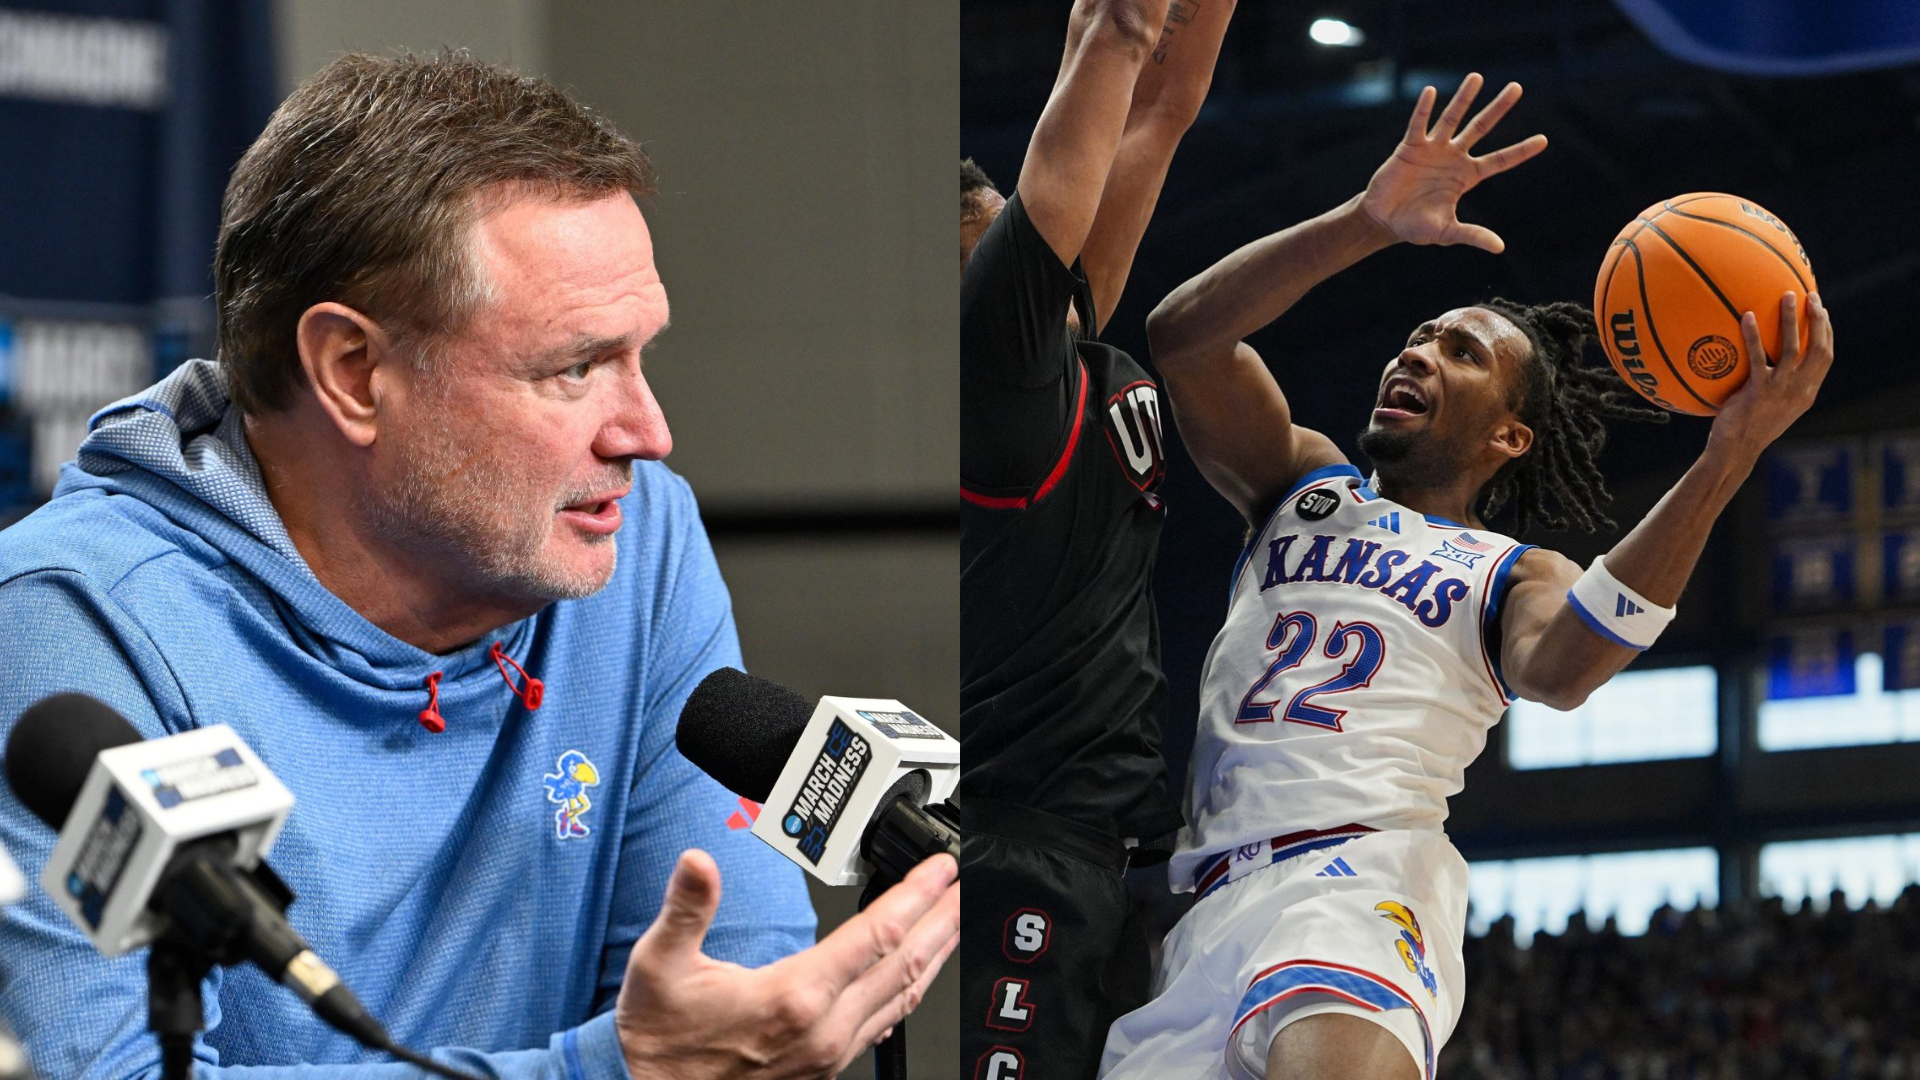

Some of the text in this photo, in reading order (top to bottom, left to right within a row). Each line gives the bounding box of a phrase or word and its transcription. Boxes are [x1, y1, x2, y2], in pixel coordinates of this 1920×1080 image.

[1260, 534, 1470, 628] KANSAS
[1234, 610, 1386, 732] 22
[793, 752, 838, 822] MARCH
[813, 735, 868, 826] MADNESS
